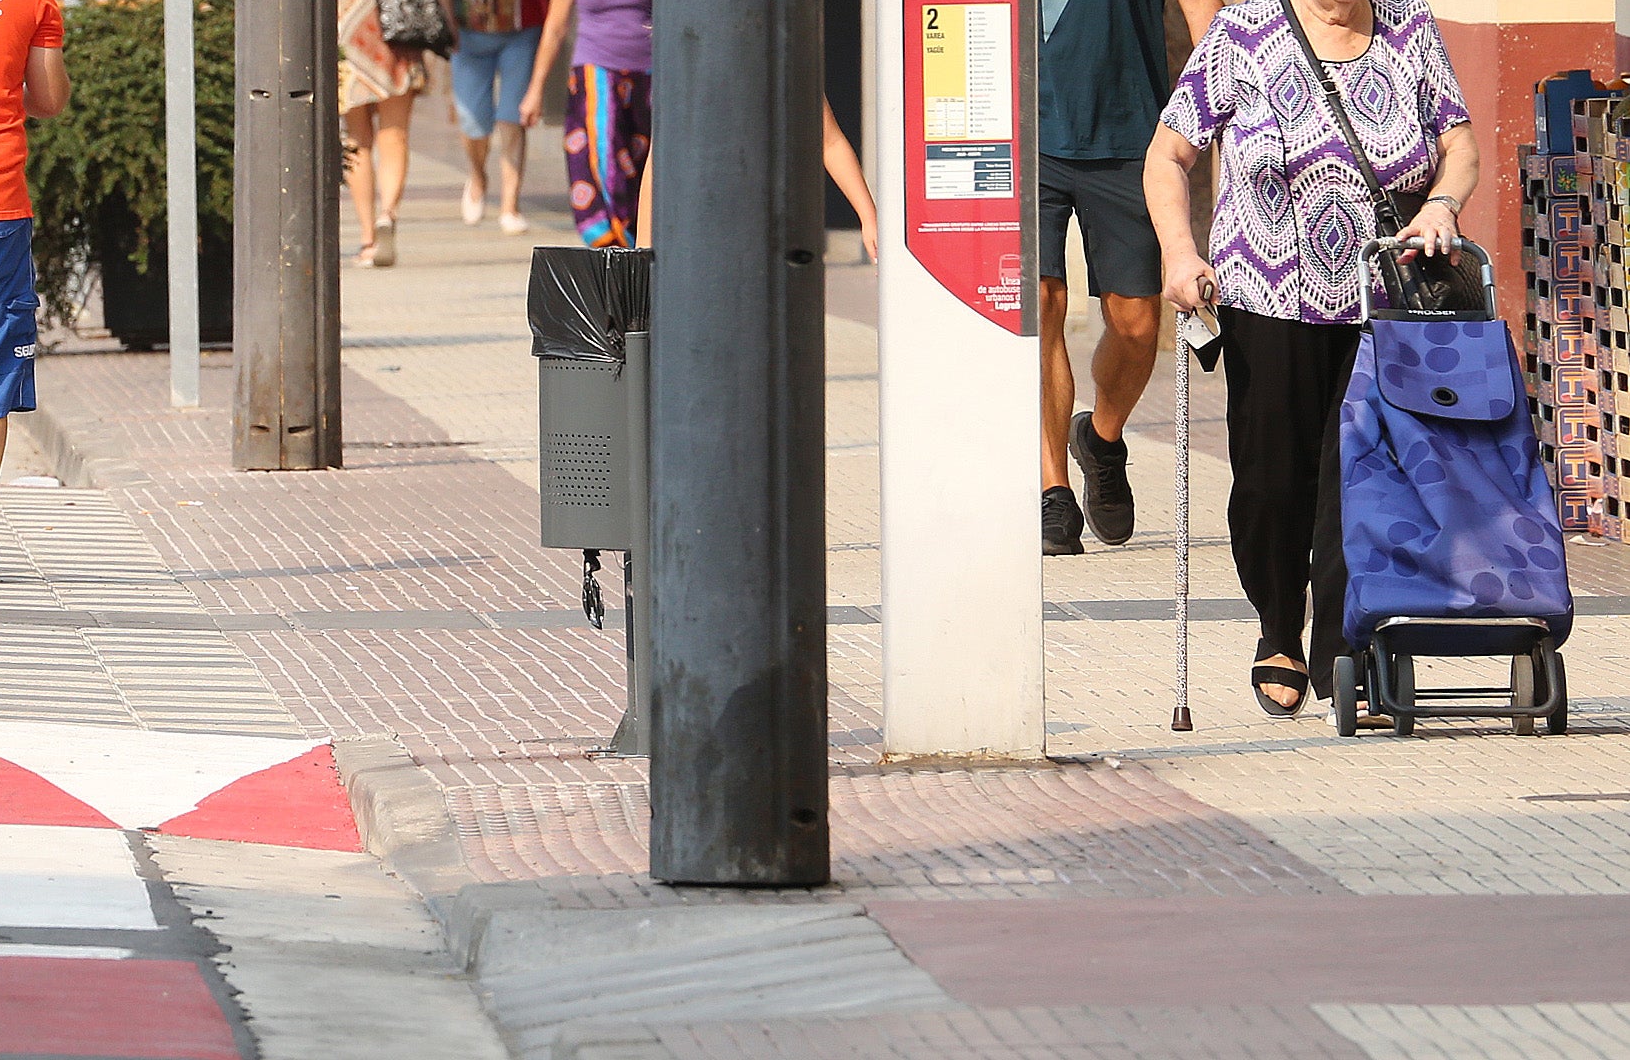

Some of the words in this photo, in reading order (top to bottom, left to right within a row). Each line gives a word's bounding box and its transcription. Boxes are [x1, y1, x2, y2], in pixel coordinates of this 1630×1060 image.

[926, 8, 939, 30] 2
[1000, 276, 1021, 286] Línea
[977, 285, 987, 294] de
[987, 285, 1021, 294] autobuse
[985, 293, 1015, 302] urbanos
